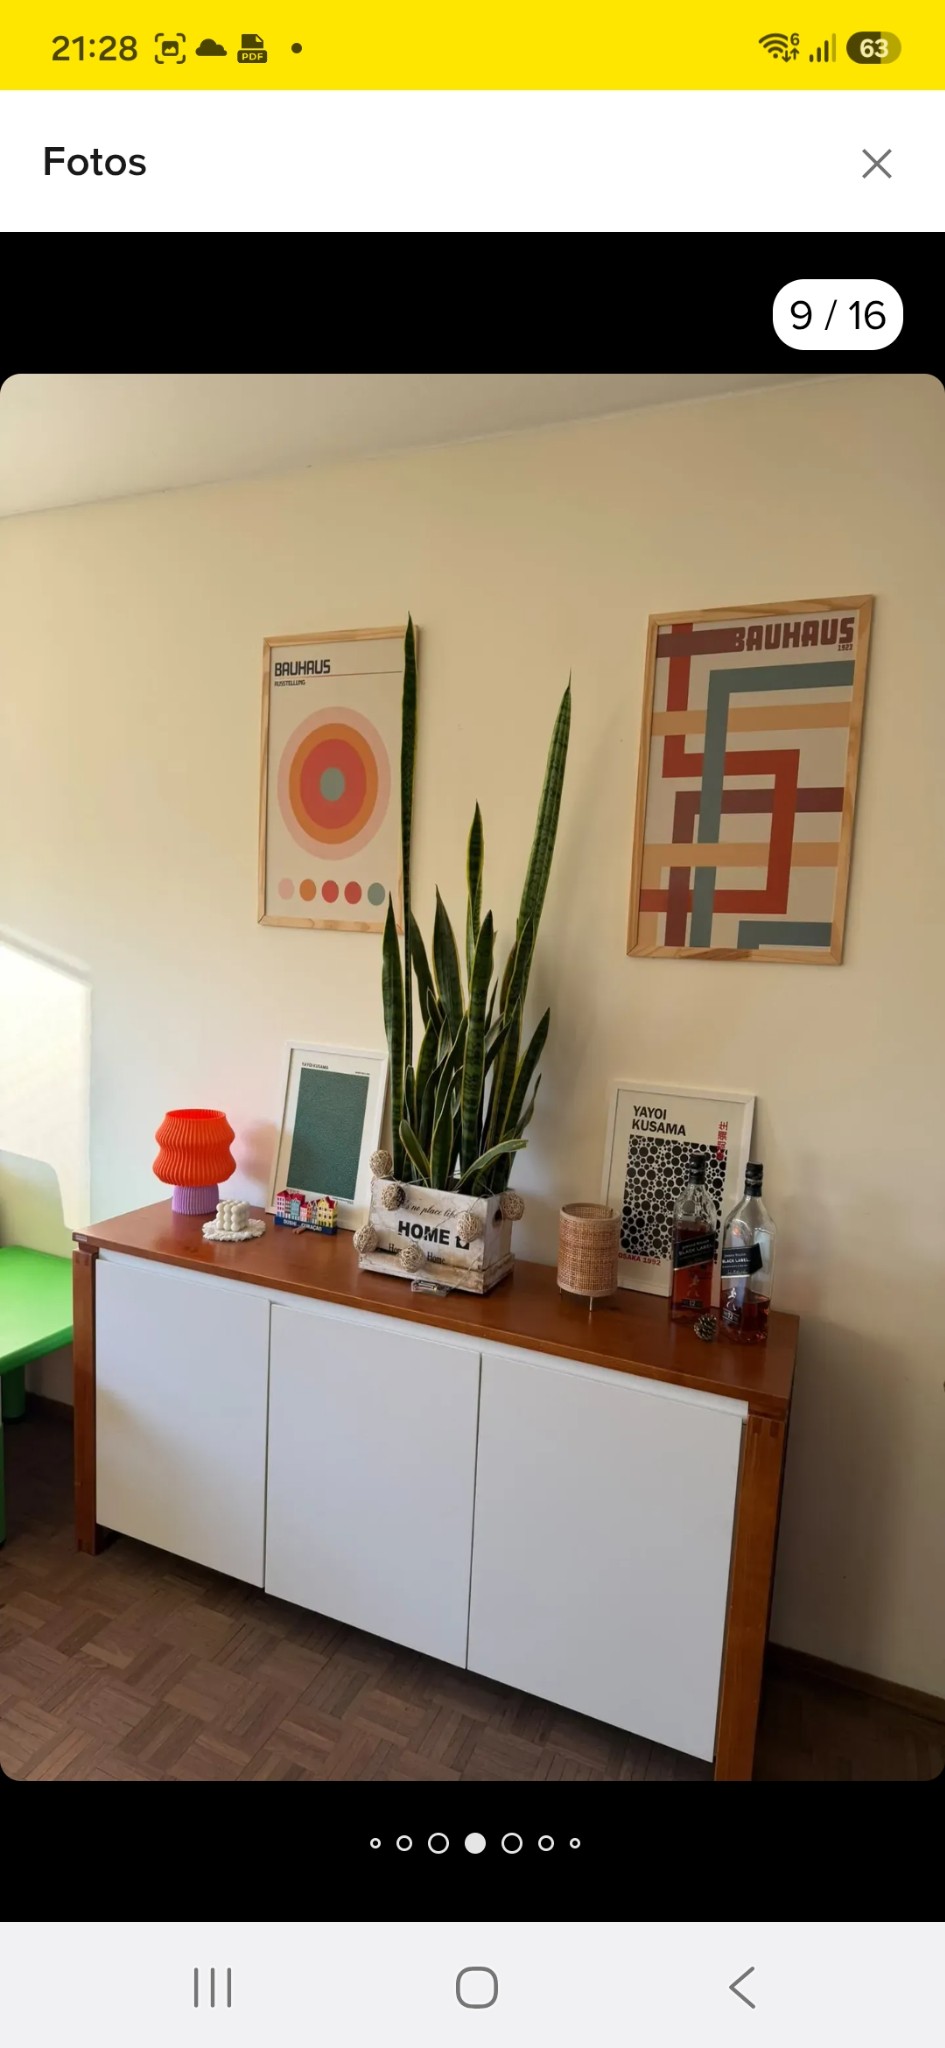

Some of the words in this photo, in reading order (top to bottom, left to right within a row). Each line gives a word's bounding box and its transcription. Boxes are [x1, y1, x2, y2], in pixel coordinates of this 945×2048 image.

[790, 32, 800, 46] 6
[51, 35, 138, 62] 21:28
[241, 52, 264, 61] PDF
[859, 38, 889, 59] 63
[44, 146, 147, 176] Fotos
[790, 300, 812, 330] 9
[824, 299, 838, 331] /
[848, 300, 886, 330] 16
[732, 616, 855, 652] BAUHAUS
[274, 659, 331, 677] BAUHAUS
[633, 1105, 667, 1120] YAYOI
[632, 1118, 686, 1137] KUSAMA
[419, 1204, 443, 1216] place
[397, 1220, 451, 1246] HOME
[388, 1243, 403, 1254] Hom
[618, 1252, 641, 1262] OSAKA
